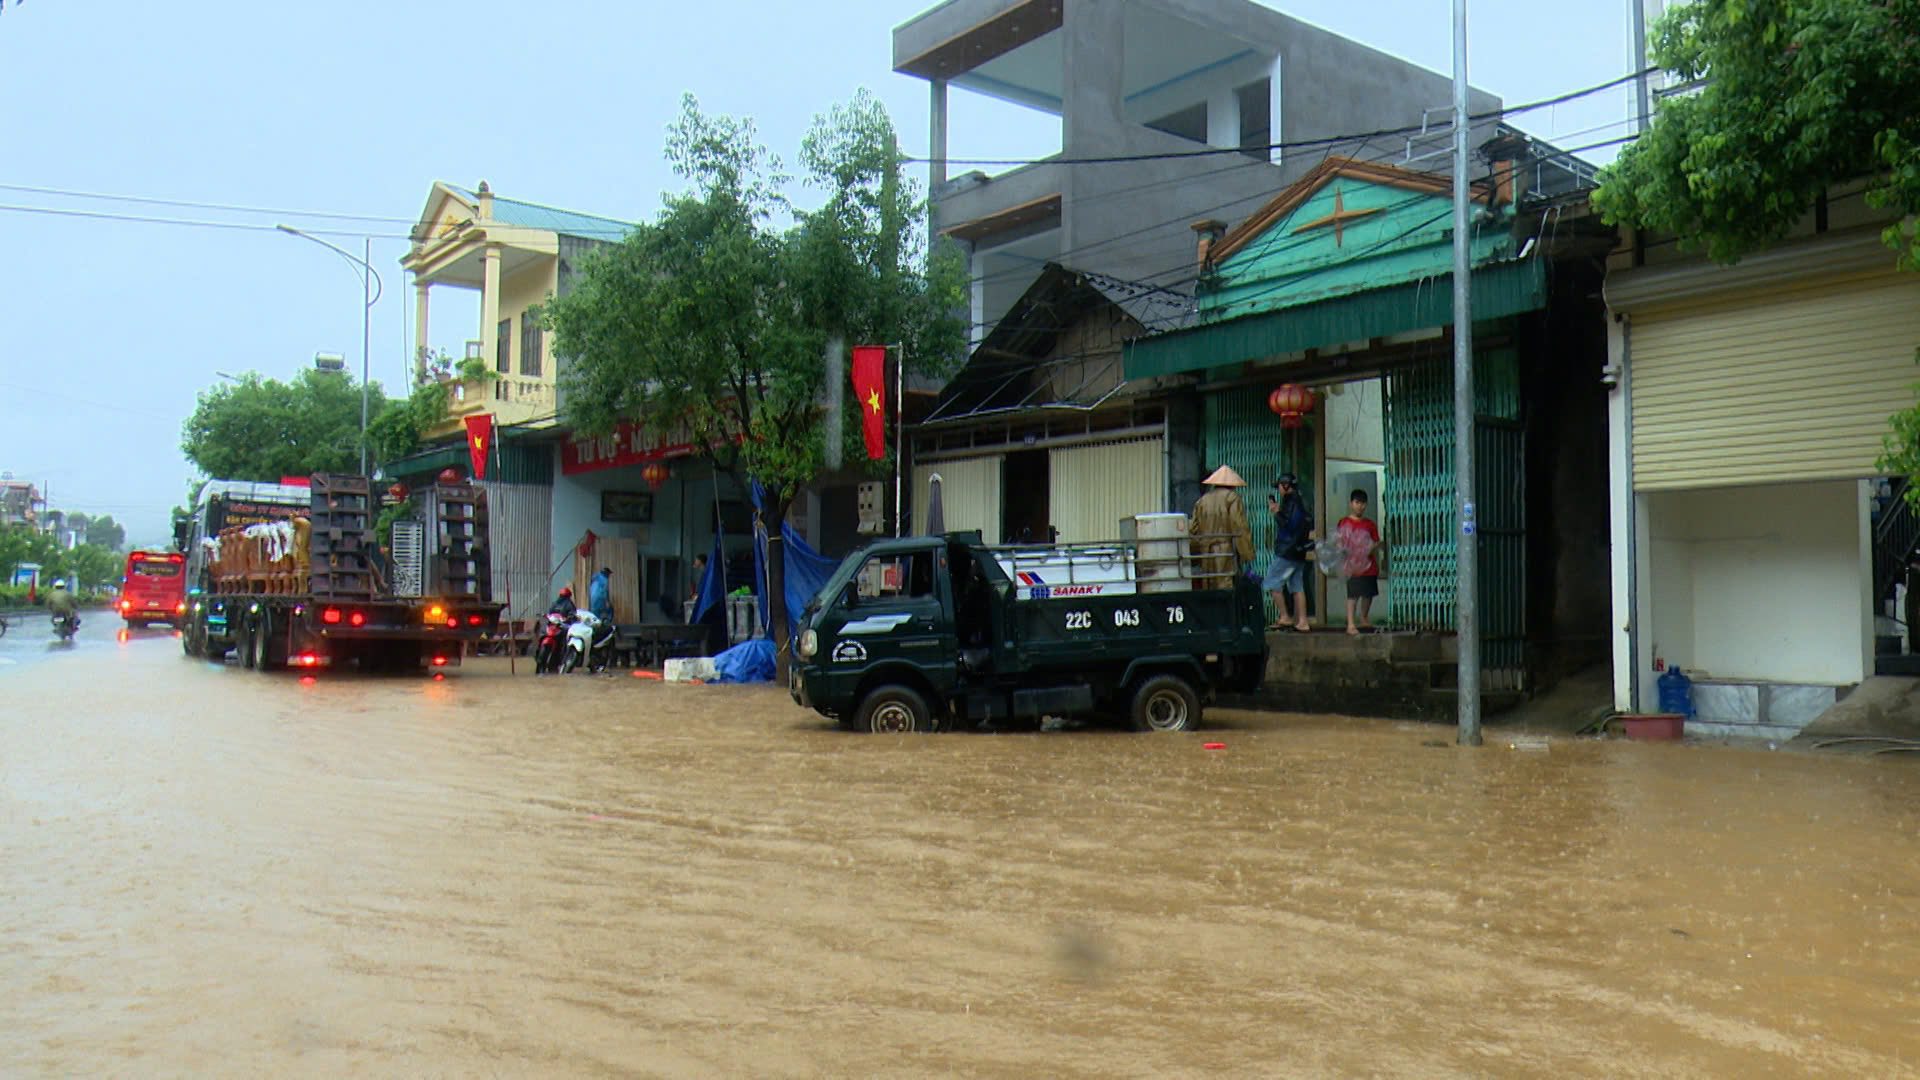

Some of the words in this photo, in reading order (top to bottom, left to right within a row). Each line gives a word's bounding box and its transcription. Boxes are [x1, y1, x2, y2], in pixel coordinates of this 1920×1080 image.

[1053, 585, 1104, 596] SANAKY
[1065, 611, 1092, 629] 22C
[1114, 609, 1140, 627] 043
[1166, 606, 1184, 623] 76
